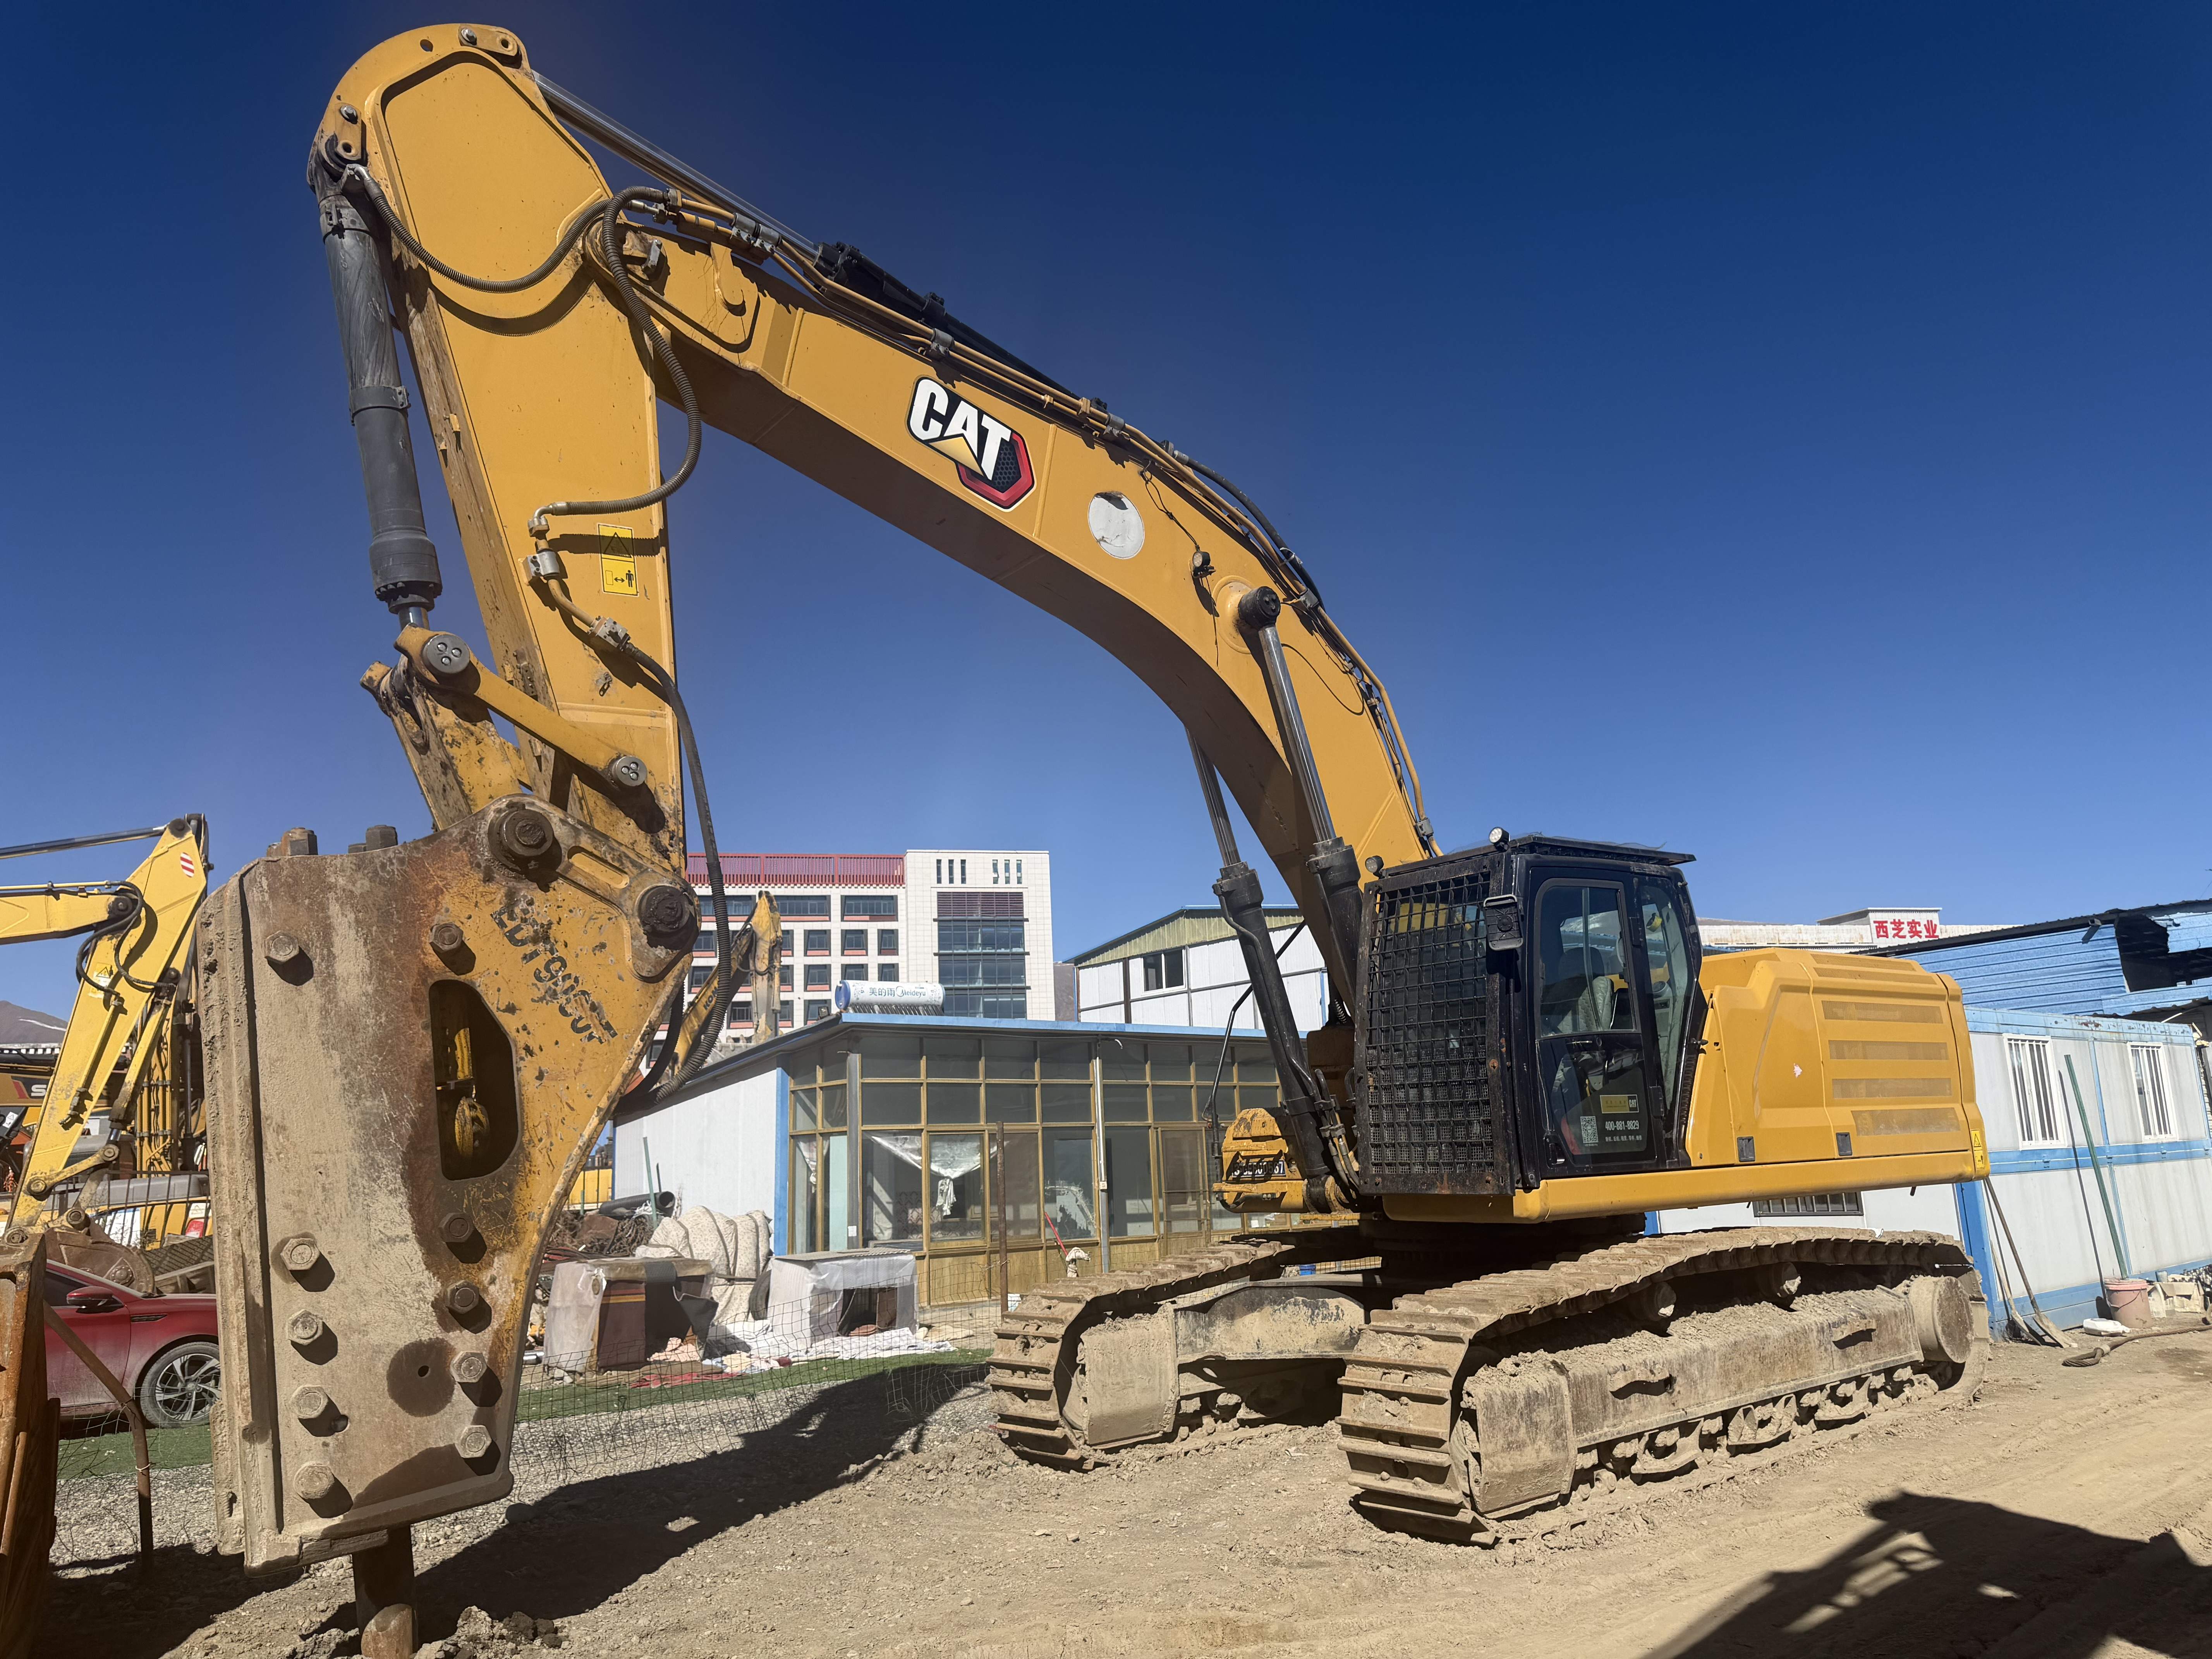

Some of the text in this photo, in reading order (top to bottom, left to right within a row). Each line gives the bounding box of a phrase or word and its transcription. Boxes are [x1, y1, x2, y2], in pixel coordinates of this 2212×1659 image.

[910, 379, 1012, 481] CAT
[1873, 919, 1939, 939] 西芝实业
[869, 987, 895, 997] 美的雨
[896, 986, 926, 998] Meideyu
